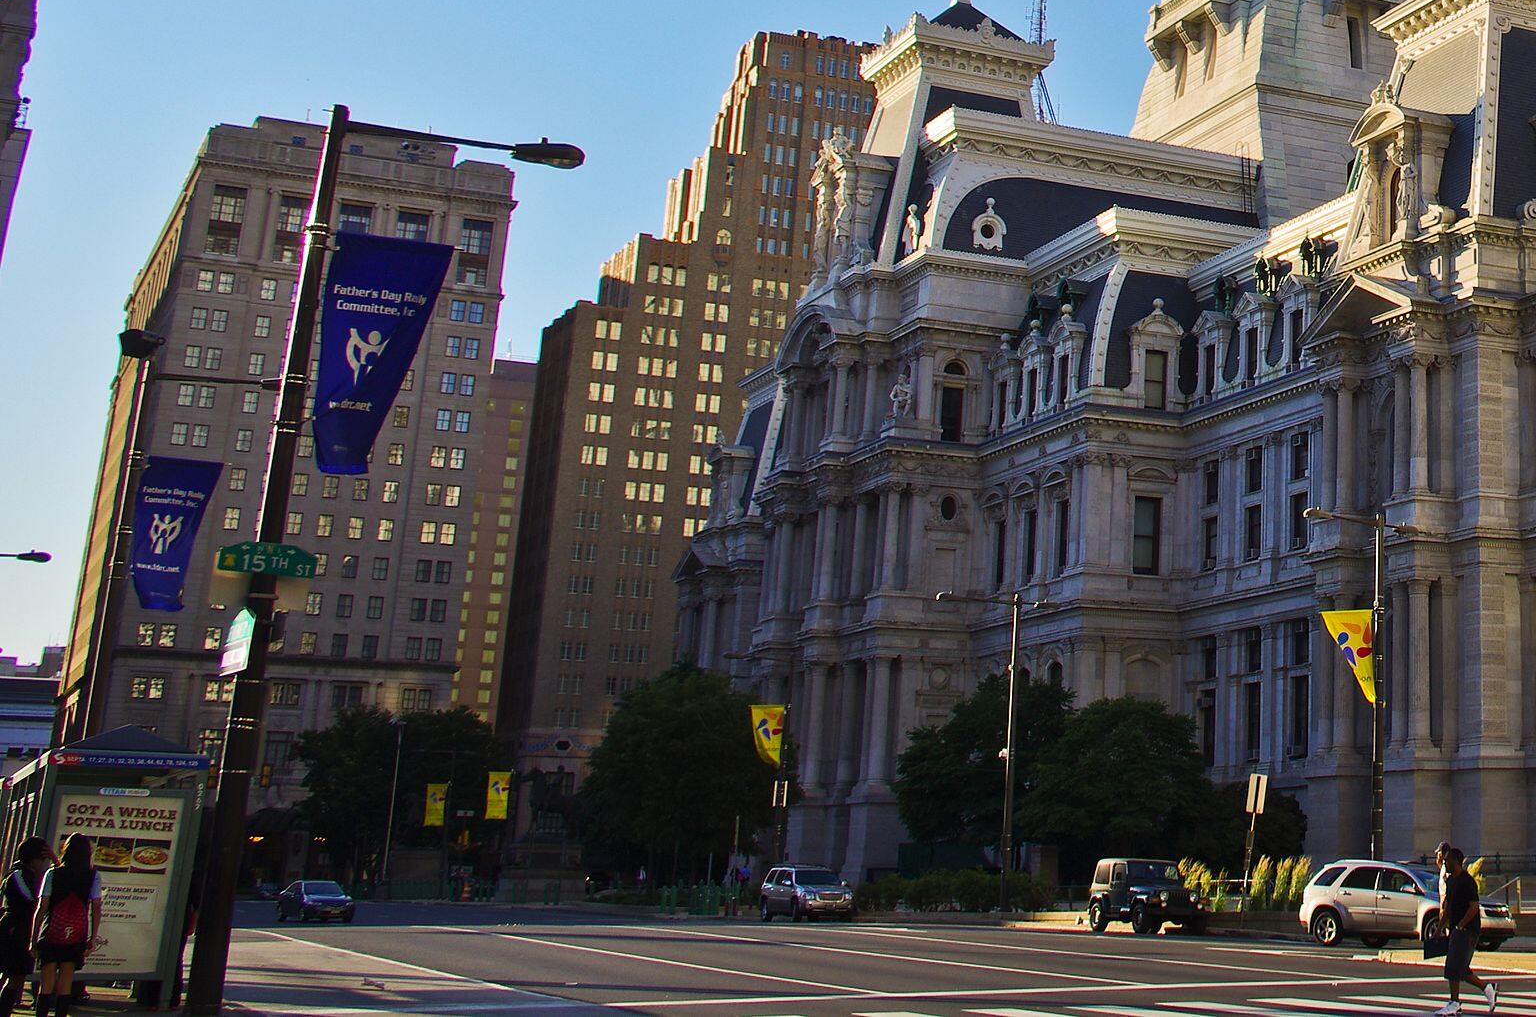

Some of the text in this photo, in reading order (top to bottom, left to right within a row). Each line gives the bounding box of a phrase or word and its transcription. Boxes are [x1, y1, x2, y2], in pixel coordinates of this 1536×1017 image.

[333, 284, 379, 299] Father's
[381, 289, 402, 303] Day
[336, 300, 401, 316] Committee,
[143, 486, 205, 500] Father's Day Rally
[296, 564, 311, 576] ST
[67, 803, 178, 820] GOT A WHOLE
[64, 816, 175, 832] LOTTA LUNCH
